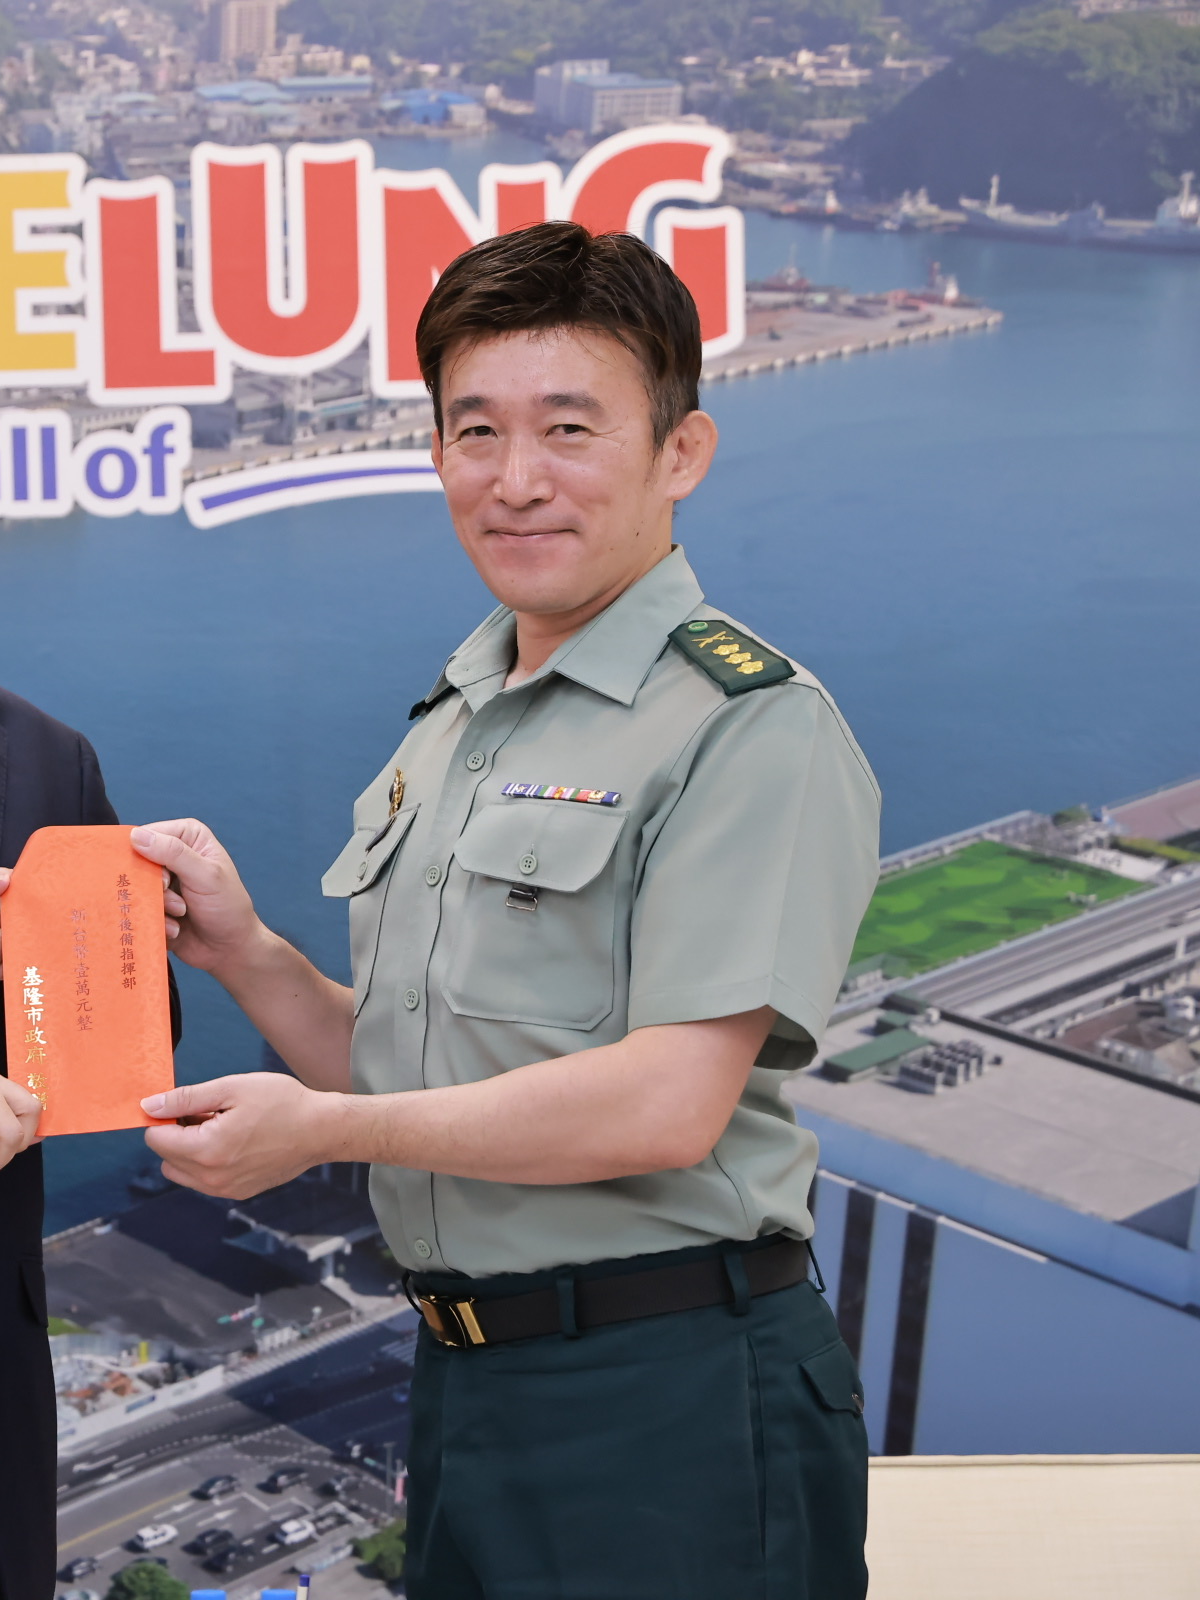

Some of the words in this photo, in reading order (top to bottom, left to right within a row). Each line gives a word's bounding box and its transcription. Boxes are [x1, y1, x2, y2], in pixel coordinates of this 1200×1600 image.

[84, 422, 177, 501] of
[70, 907, 93, 1032] 新台幣壹萬元整
[115, 873, 137, 990] 基隆市後備指揮部
